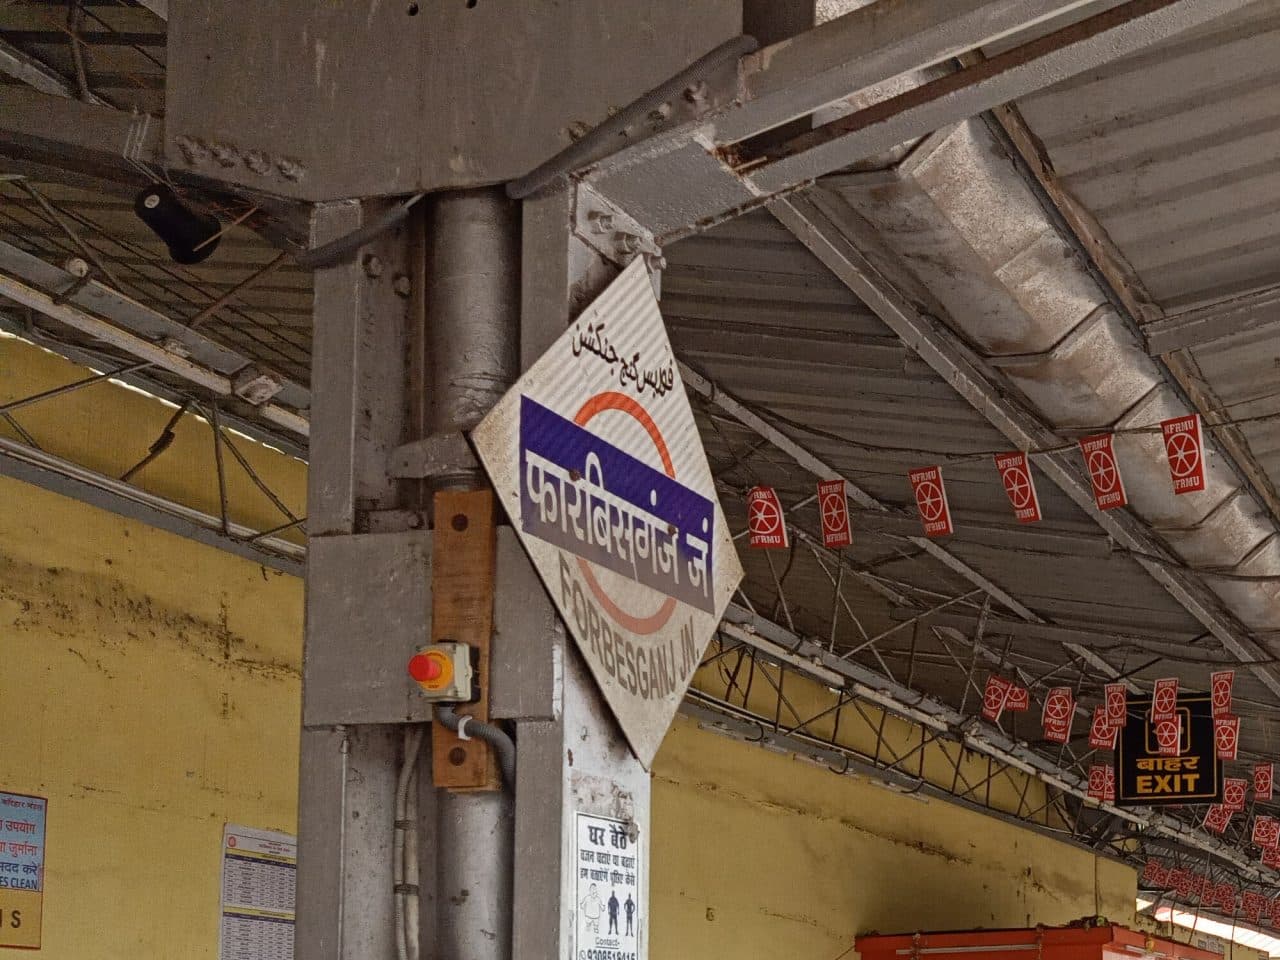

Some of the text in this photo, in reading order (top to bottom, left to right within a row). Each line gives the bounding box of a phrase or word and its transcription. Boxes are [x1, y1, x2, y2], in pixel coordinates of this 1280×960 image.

[558, 549, 676, 700] FORBESGANJ
[1136, 756, 1200, 771] बाहर
[1136, 773, 1200, 793] EXIT
[588, 826, 606, 846] घर
[11, 878, 38, 890] CLEAN
